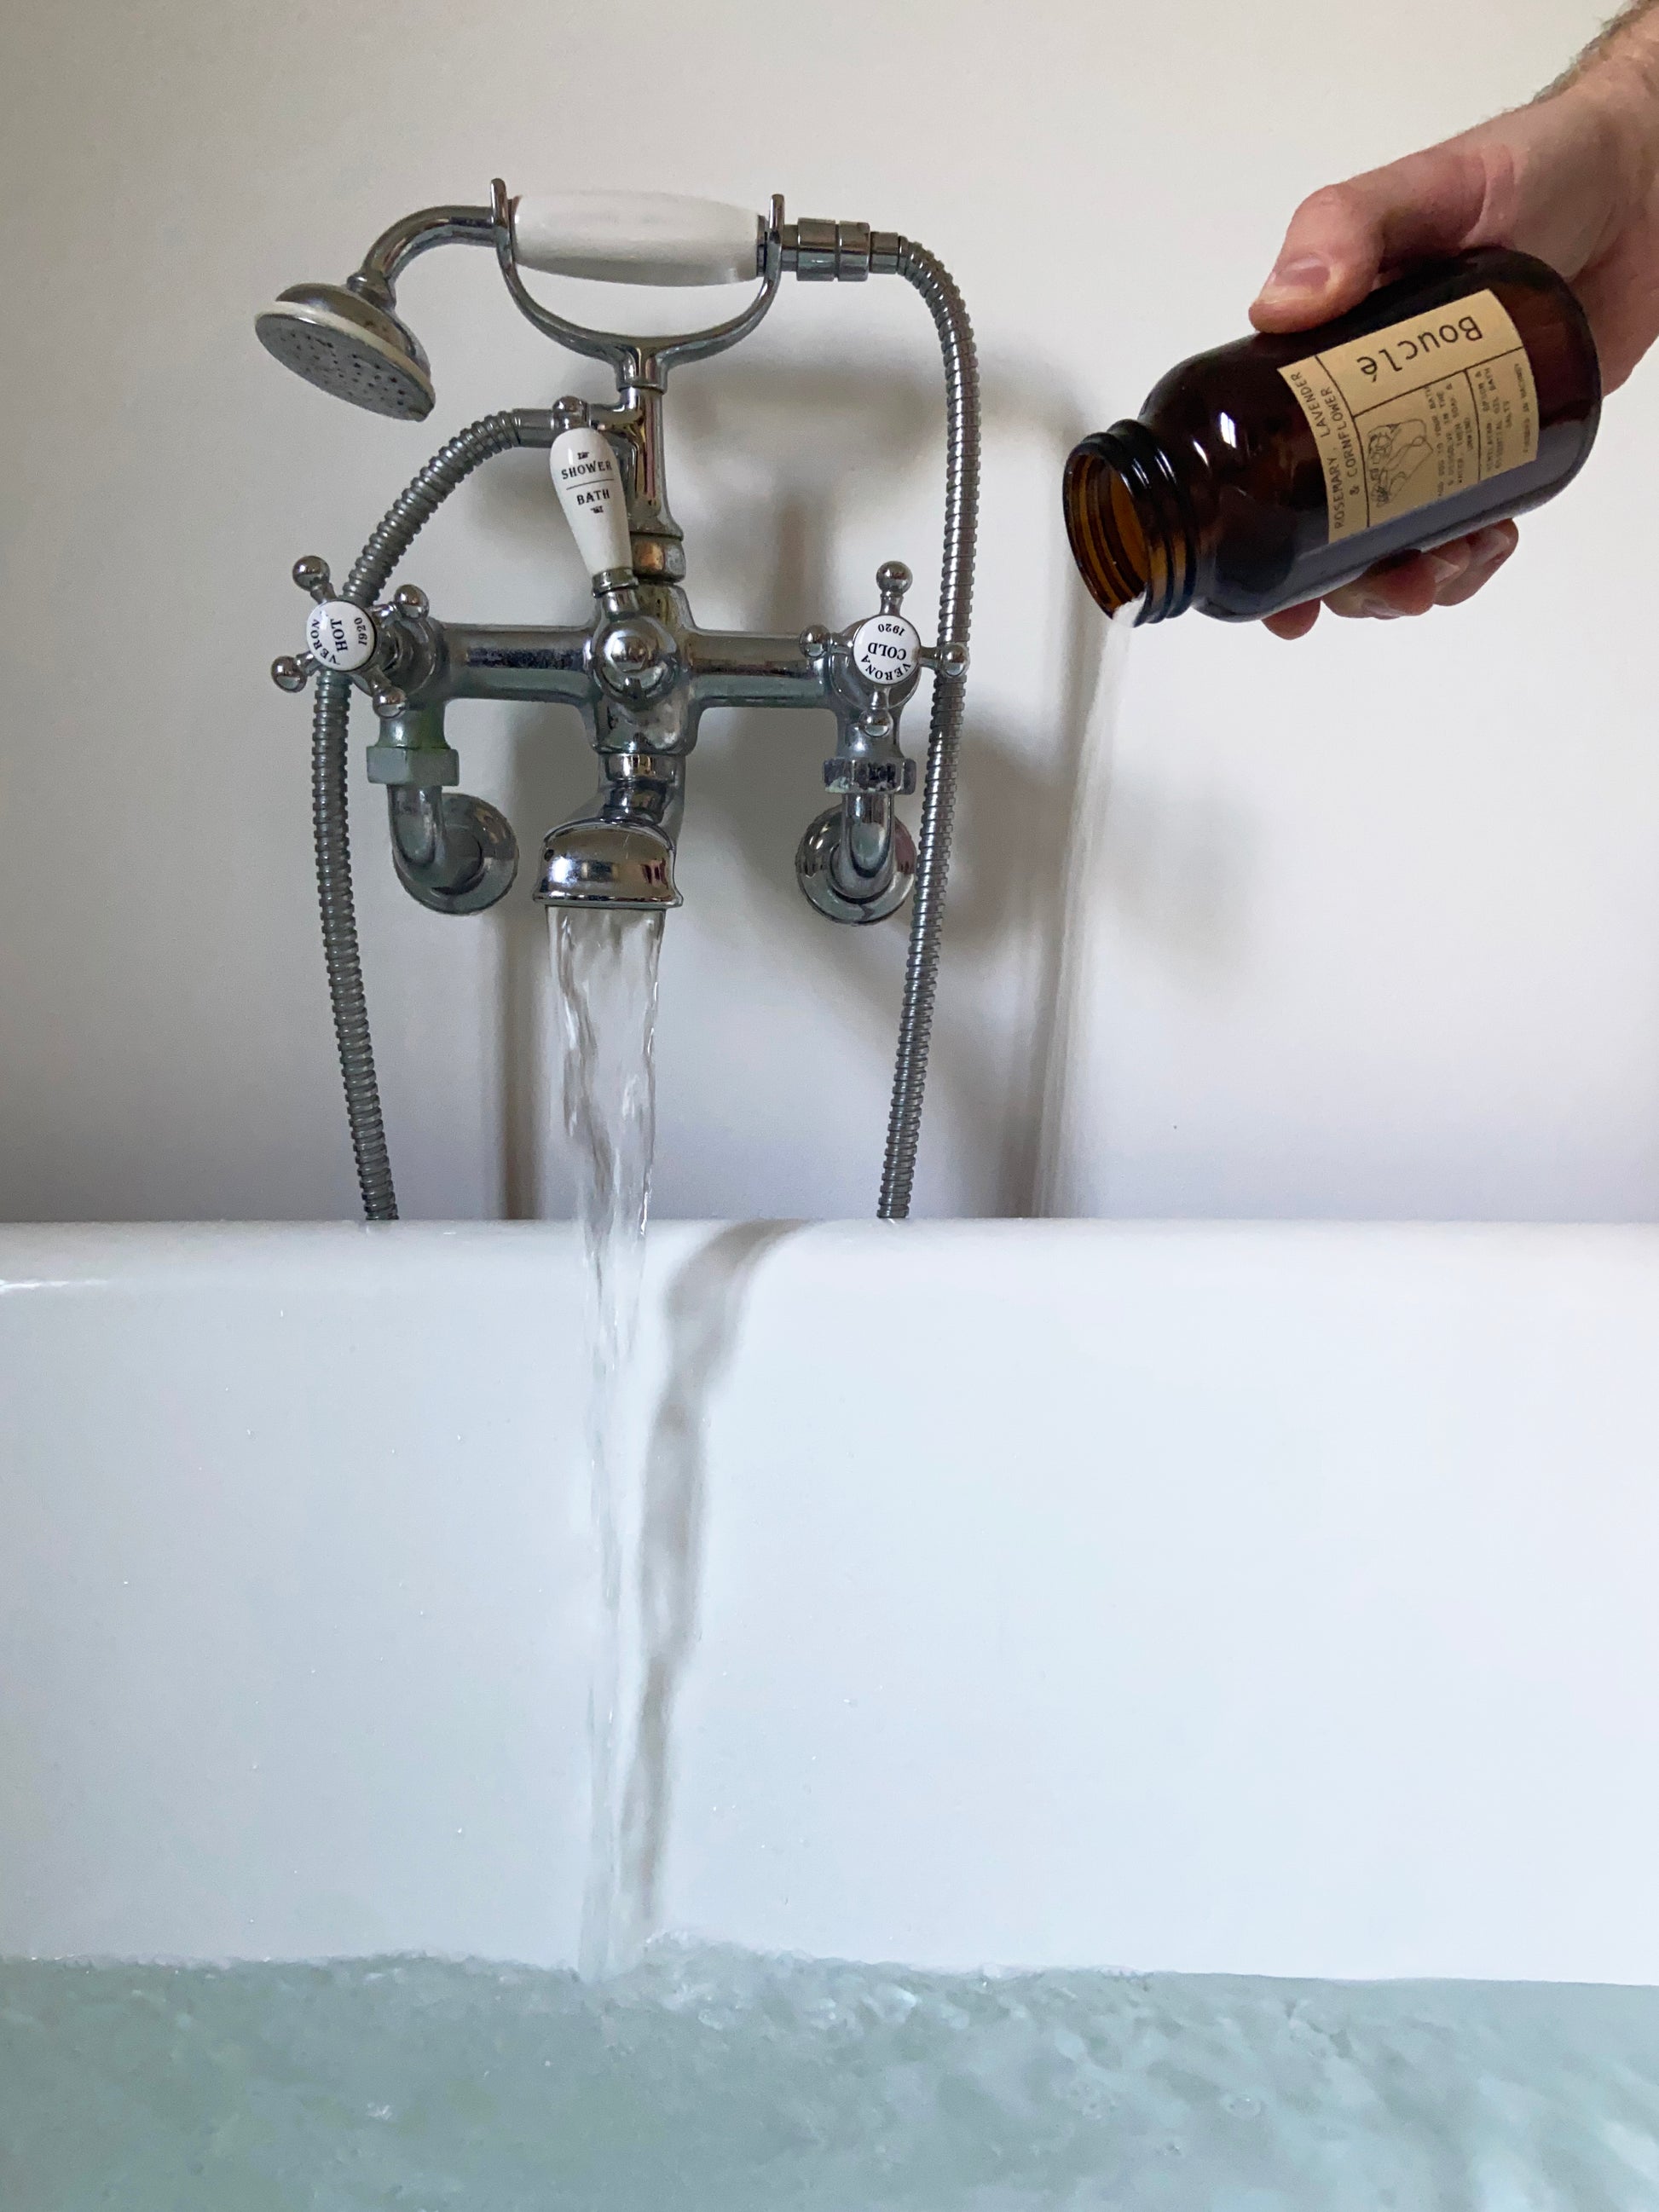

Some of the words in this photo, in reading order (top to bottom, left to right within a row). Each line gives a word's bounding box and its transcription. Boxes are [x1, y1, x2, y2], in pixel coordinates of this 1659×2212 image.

[1356, 315, 1483, 382] Bouclé
[1291, 372, 1332, 437] LAVENDER
[1321, 386, 1357, 477] CORNFLOWER
[561, 460, 612, 480] SHOWER
[576, 488, 610, 505] BATH
[1350, 486, 1361, 496] &
[309, 611, 341, 665] VERON
[330, 618, 348, 651] HOT
[354, 617, 367, 645] 1920
[878, 623, 905, 636] 1920
[868, 642, 906, 661] COLD
[861, 655, 911, 680] VERONA
